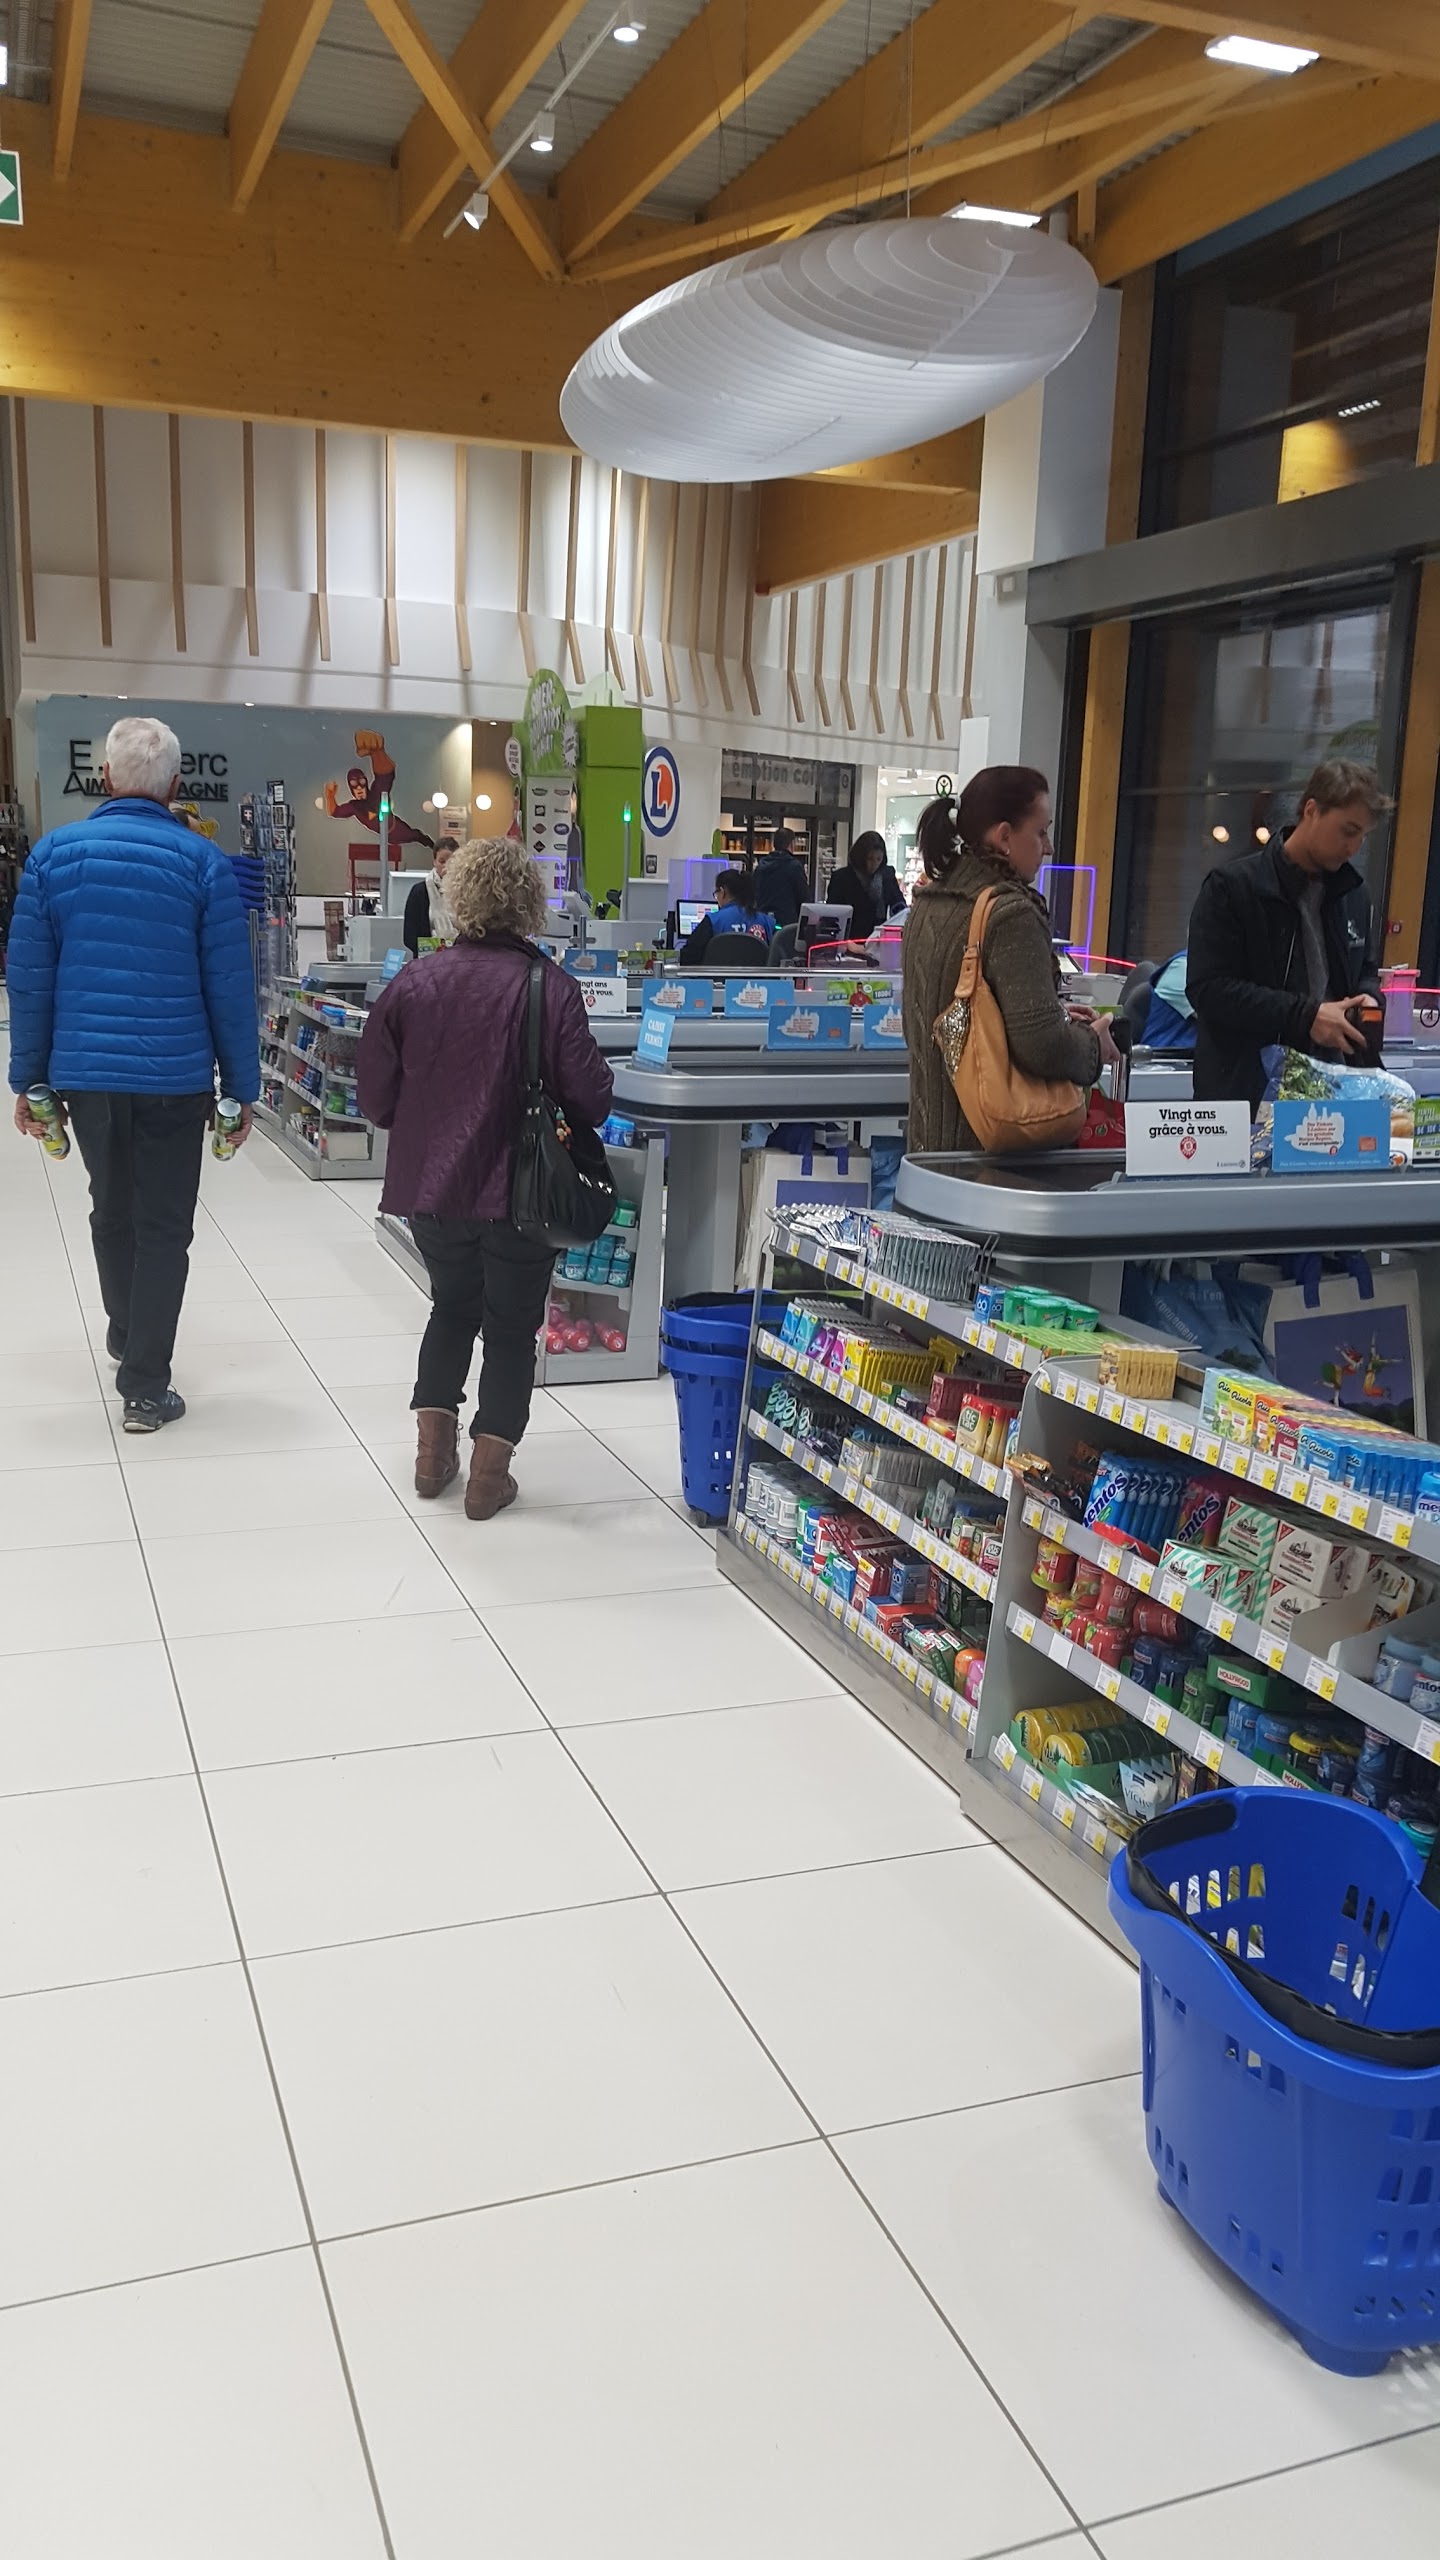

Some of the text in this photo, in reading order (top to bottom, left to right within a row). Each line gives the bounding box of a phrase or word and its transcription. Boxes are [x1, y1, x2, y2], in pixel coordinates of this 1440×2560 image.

[1159, 1109, 1216, 1122] Vingt ans
[1149, 1123, 1228, 1138] grâce à vous.
[1218, 1381, 1231, 1393] Ric
[1231, 1391, 1252, 1407] Ricola
[964, 1409, 978, 1421] tic
[962, 1420, 975, 1431] tac
[1308, 1440, 1336, 1459] Ricola
[1177, 1495, 1218, 1543] entos
[1218, 1669, 1250, 1688] HOLLYWOOD
